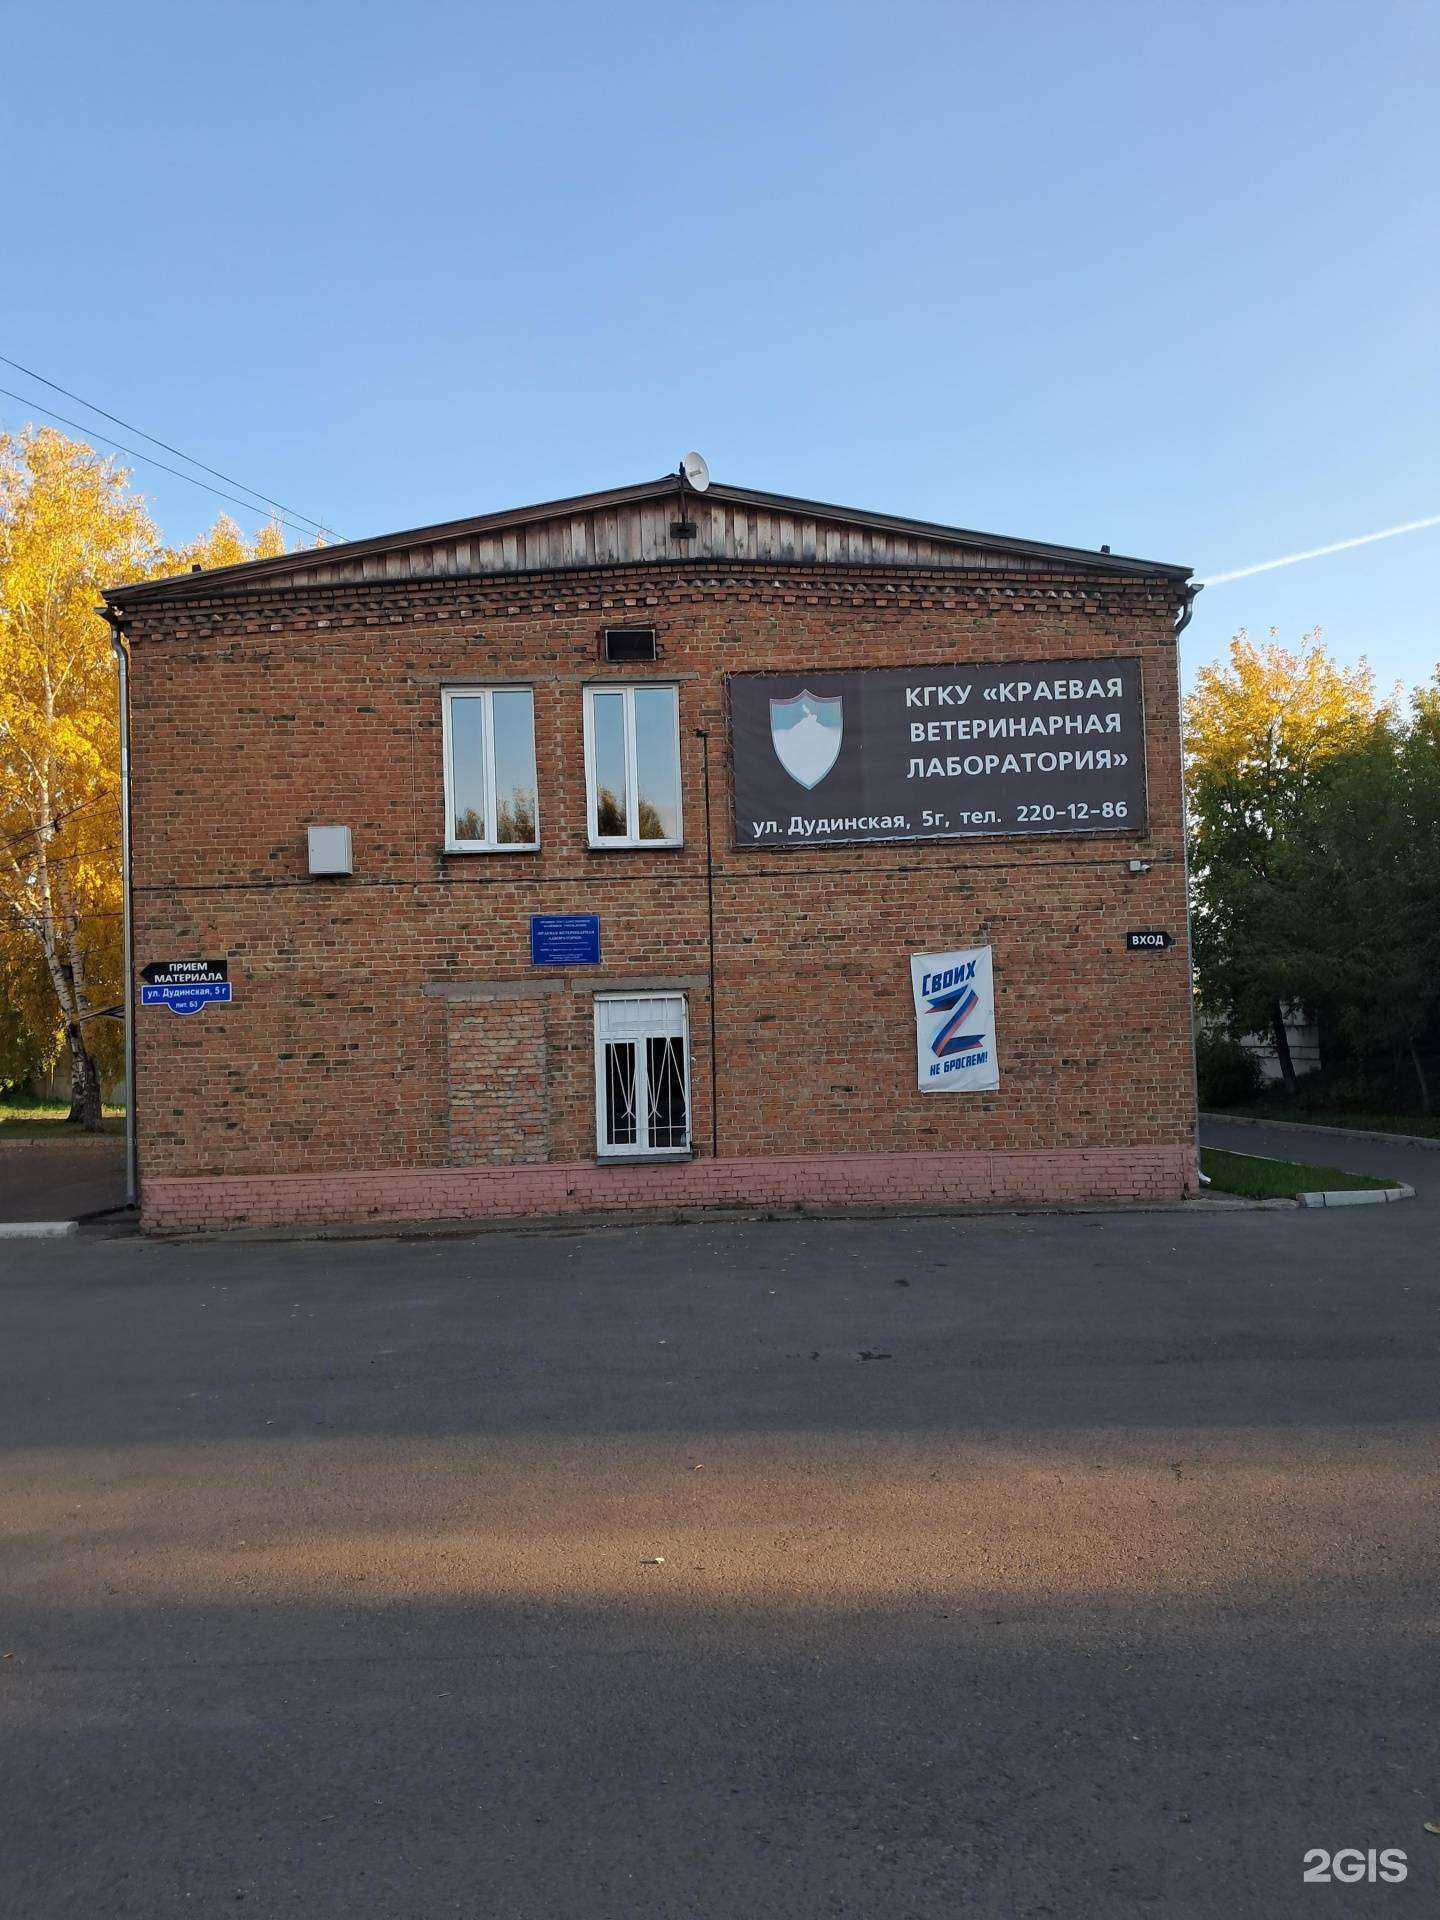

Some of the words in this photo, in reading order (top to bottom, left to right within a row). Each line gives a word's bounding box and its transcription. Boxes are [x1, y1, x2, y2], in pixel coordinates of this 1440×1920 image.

[905, 684, 972, 708] КГКУ
[983, 677, 1123, 703] «КРАЕВАЯ
[909, 713, 1122, 743] ВЕТЕРИНАРНАЯ
[906, 749, 1129, 779] ЛАБОРАТОРИЯ»
[752, 819, 783, 838] ул.
[787, 814, 912, 836] Дудинская,
[921, 810, 951, 830] 5г,
[959, 808, 1002, 825] тел.
[1016, 801, 1129, 822] 220-12-86
[1132, 935, 1164, 946] ВХОД
[154, 973, 223, 983] МАТЕРИАЛА
[169, 963, 208, 972] ПРИЕМ
[922, 960, 977, 997] СВОИХ
[162, 987, 213, 998] Дудинская,
[930, 1063, 940, 1076] НЕ
[943, 1052, 988, 1073] БРОСАЕМ!
